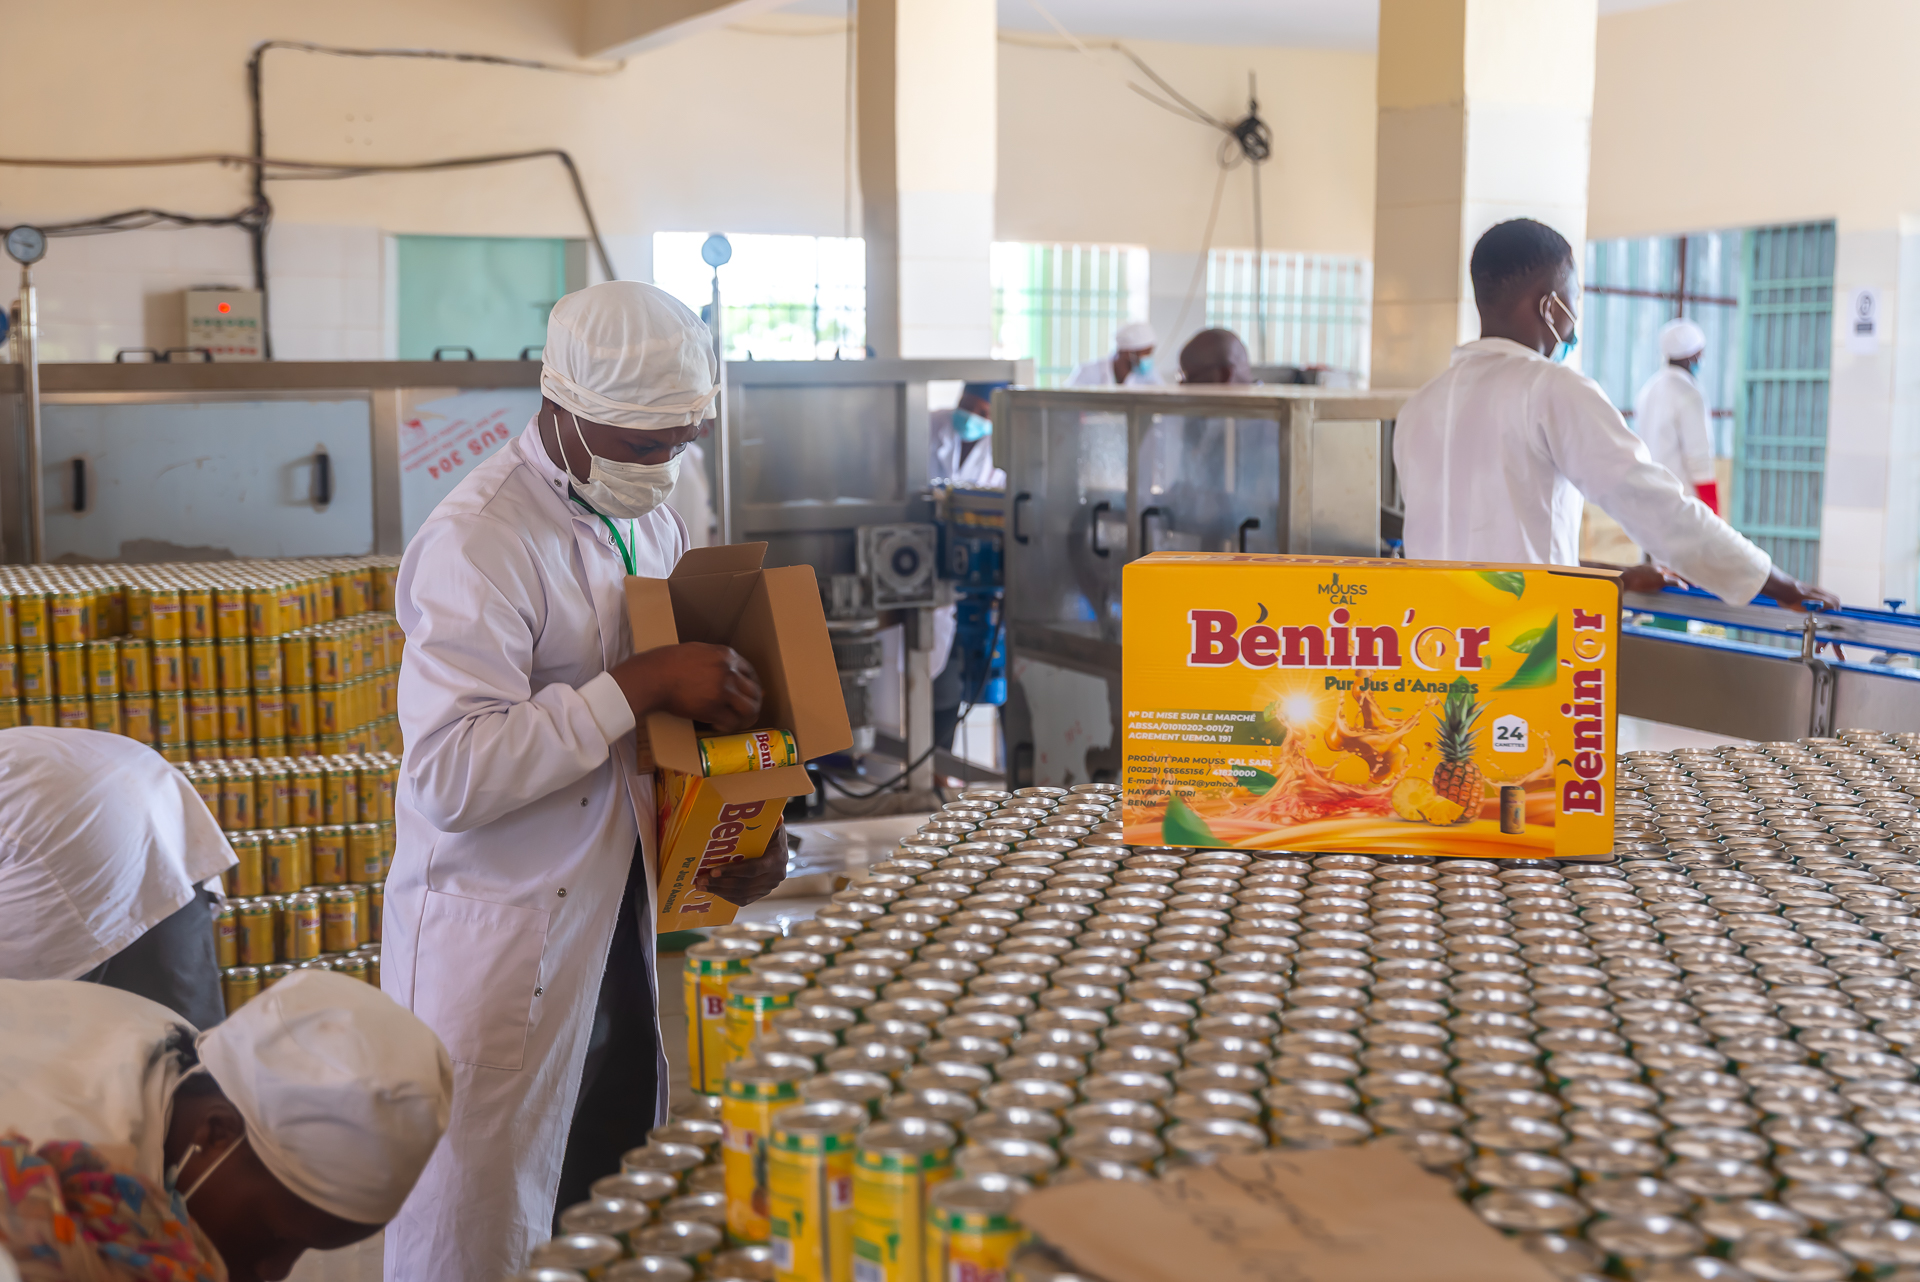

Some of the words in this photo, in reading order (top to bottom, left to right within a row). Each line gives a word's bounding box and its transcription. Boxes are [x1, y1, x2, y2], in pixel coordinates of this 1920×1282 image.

[467, 422, 510, 456] SUS
[427, 449, 465, 480] 304
[1318, 583, 1368, 596] MOUSS
[1329, 594, 1358, 605] CAL
[1325, 676, 1354, 691] Pur
[1359, 677, 1389, 692] Jus
[1393, 678, 1479, 694] d'Ananas
[1141, 711, 1155, 719] DE
[1156, 712, 1179, 720] MISE
[1180, 712, 1200, 720] SUR
[1201, 713, 1214, 721] LE
[1215, 712, 1257, 722] MARCHÉ
[1128, 732, 1180, 741] AGREMENT
[1181, 734, 1217, 743] UEMOA
[1218, 735, 1232, 743] 191
[1496, 726, 1525, 741] 24
[1127, 754, 1170, 763] PRODUIT
[1170, 756, 1191, 764] PAR
[1192, 757, 1226, 765] MOUSS
[1227, 758, 1248, 766] CAL
[1248, 759, 1273, 767] SARL
[1127, 765, 1161, 775] (00229)
[1163, 767, 1205, 776] 66565156
[1127, 777, 1159, 785] E-mail:
[1127, 788, 1171, 797] HAYAKPA
[1174, 789, 1197, 797] TORI
[1127, 799, 1157, 807] BENIN
[684, 856, 696, 868] Pur
[675, 870, 690, 882] Jus
